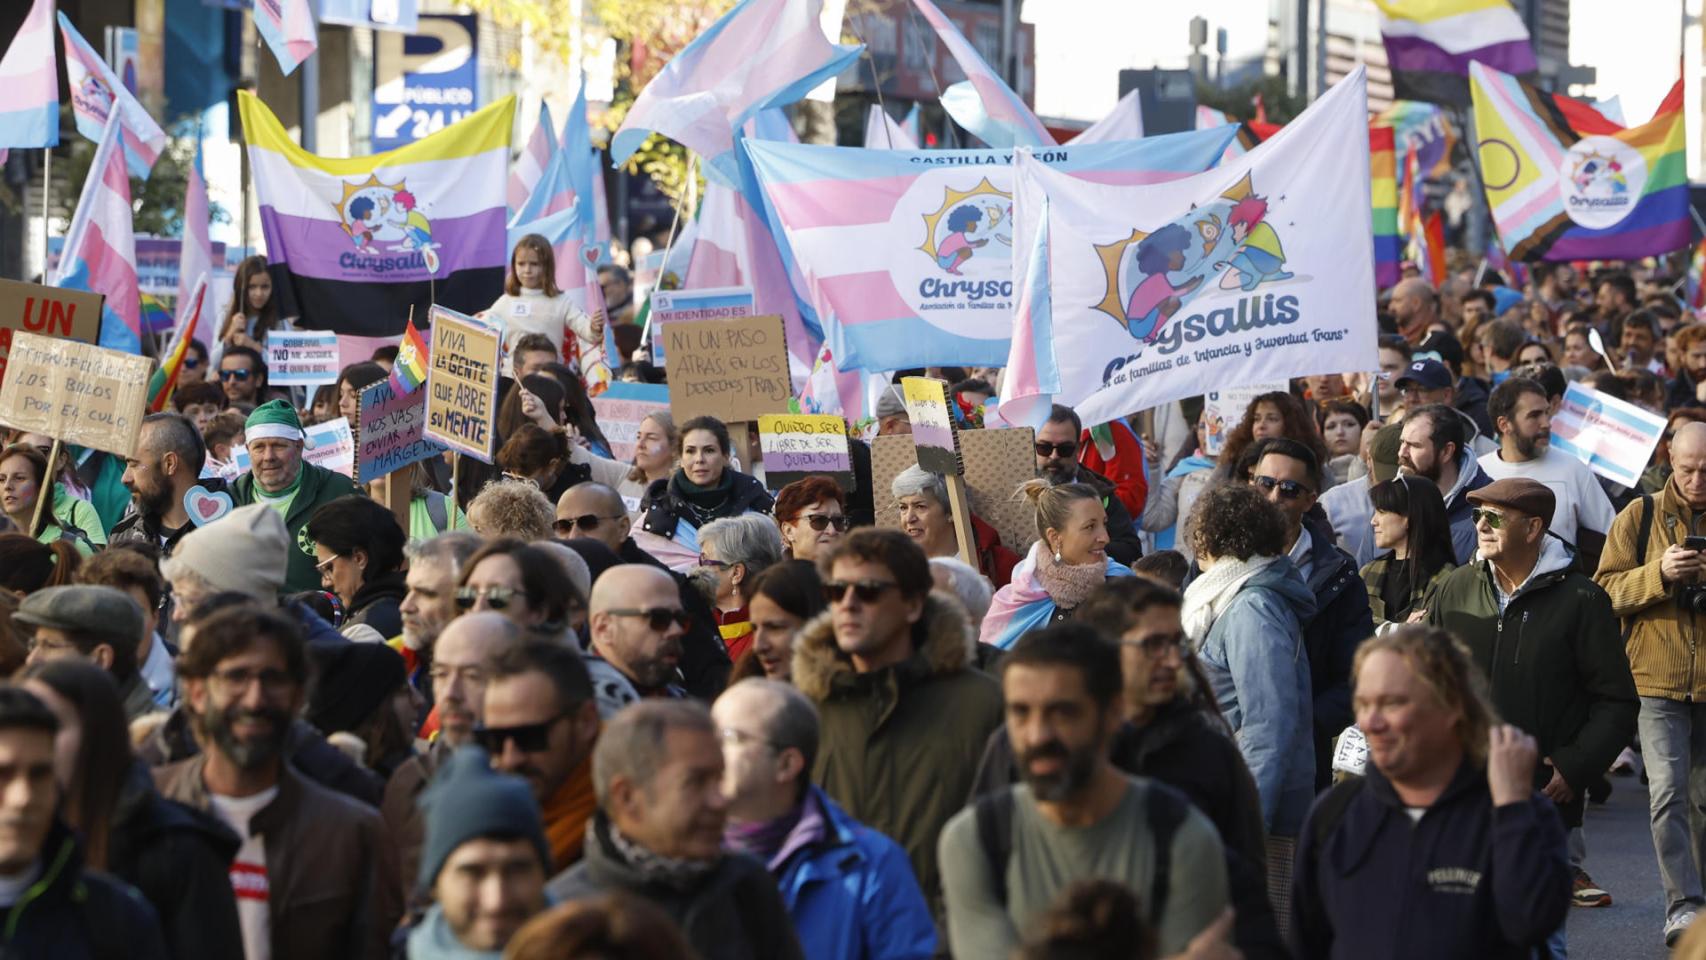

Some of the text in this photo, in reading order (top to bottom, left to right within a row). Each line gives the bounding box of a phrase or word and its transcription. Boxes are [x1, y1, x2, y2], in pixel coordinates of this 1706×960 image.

[374, 17, 472, 104] P
[910, 151, 1068, 165] CASTILLA Y EÓN
[339, 252, 425, 273] Chrysall
[919, 278, 1013, 300] Chrysa
[23, 297, 77, 337] UN
[661, 307, 746, 320] MI IDENTIDAD ES
[440, 326, 466, 352] VIVA
[672, 329, 767, 351] NI UN PASO
[273, 349, 289, 361] NO
[753, 355, 780, 373] LOS
[1113, 374, 1127, 385] de
[1176, 355, 1191, 367] de
[1194, 344, 1241, 362] Infancia
[1244, 342, 1252, 357] y
[1255, 332, 1309, 350] Juventud
[436, 353, 488, 384] LA GENTE
[15, 372, 48, 388] LOS
[66, 378, 112, 399] BOLOS
[24, 397, 52, 412] POR
[435, 383, 487, 416] QUE ABRE
[368, 406, 414, 433] NOS VAS
[431, 407, 488, 445] SU MENTE
[774, 421, 843, 435] QUIERO SER
[366, 430, 401, 455] ENVIAR
[407, 425, 416, 438] A
[769, 438, 835, 453] LIBRE DE SER
[819, 452, 840, 469] SOY
